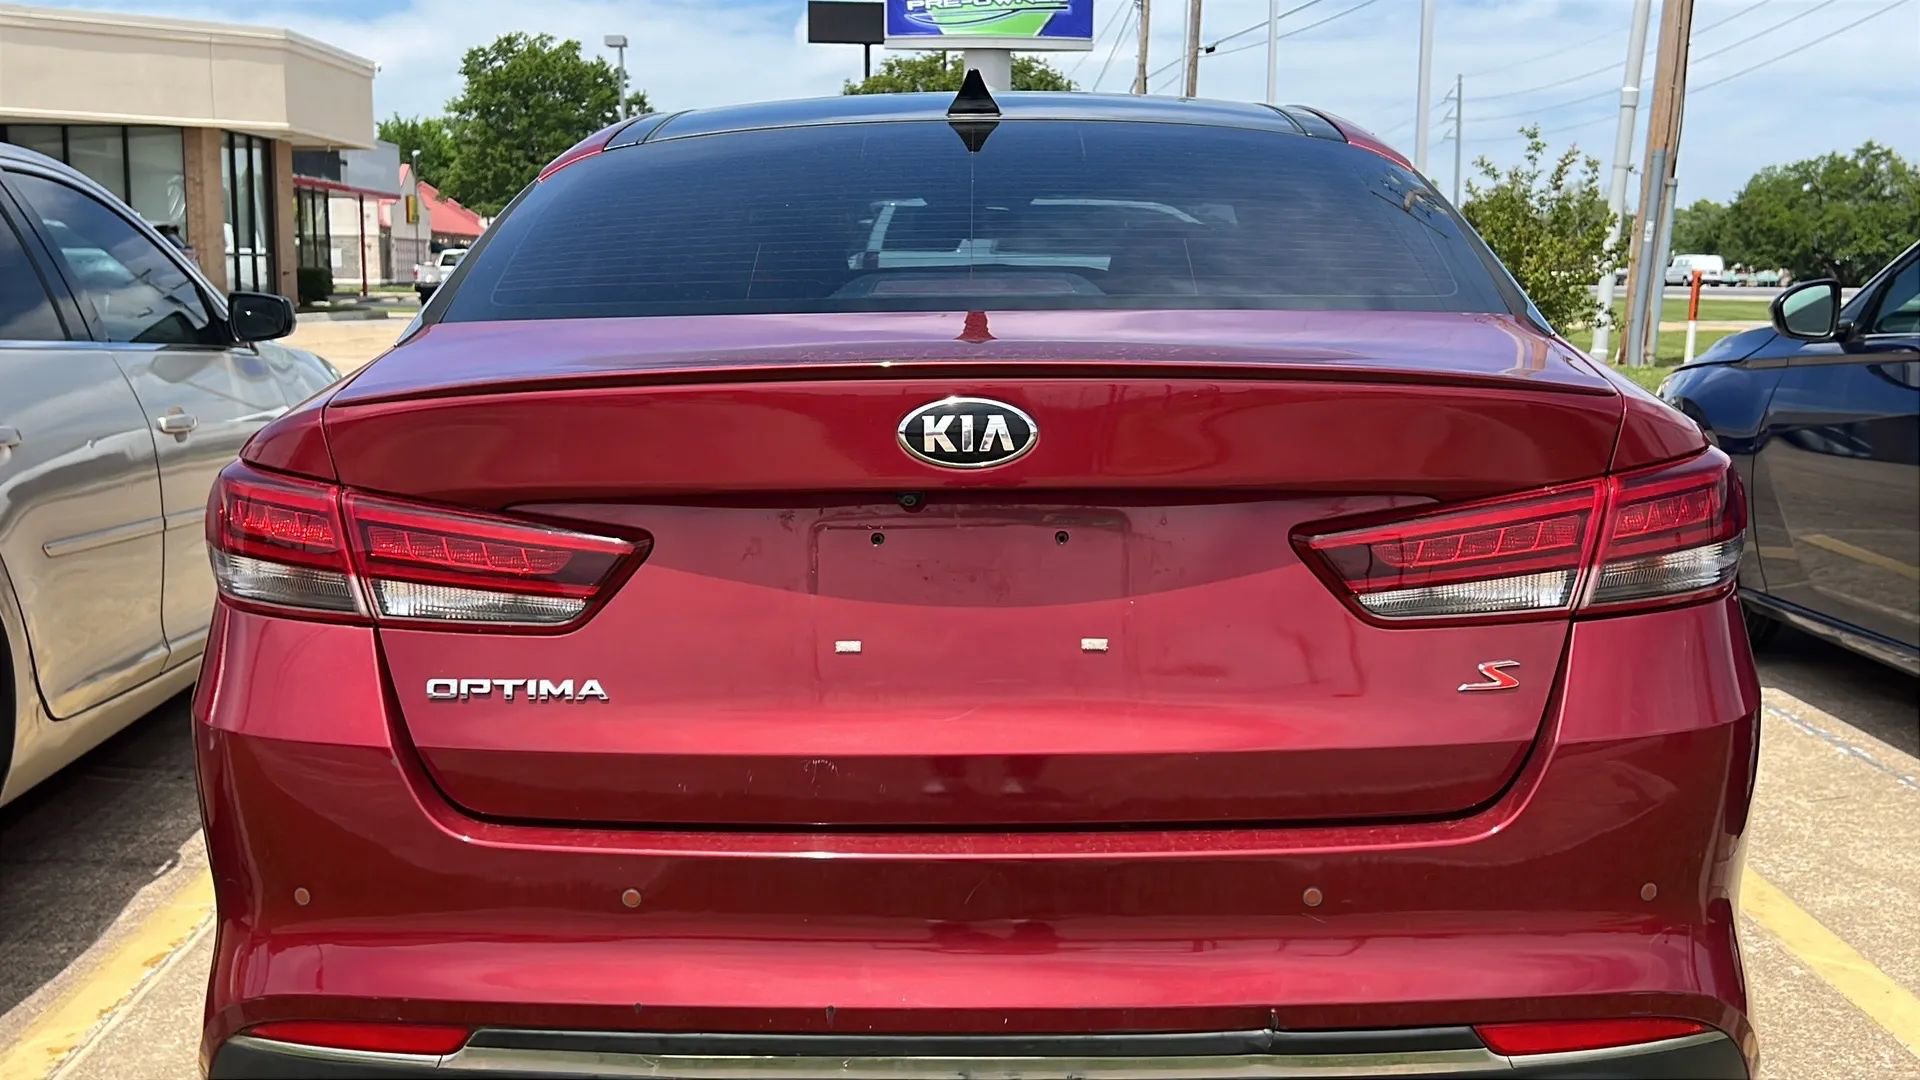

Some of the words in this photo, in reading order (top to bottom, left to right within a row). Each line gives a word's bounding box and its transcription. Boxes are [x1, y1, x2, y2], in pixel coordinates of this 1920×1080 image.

[922, 414, 1015, 453] KIA
[426, 678, 610, 701] OPTIMA
[1457, 659, 1521, 692] S
